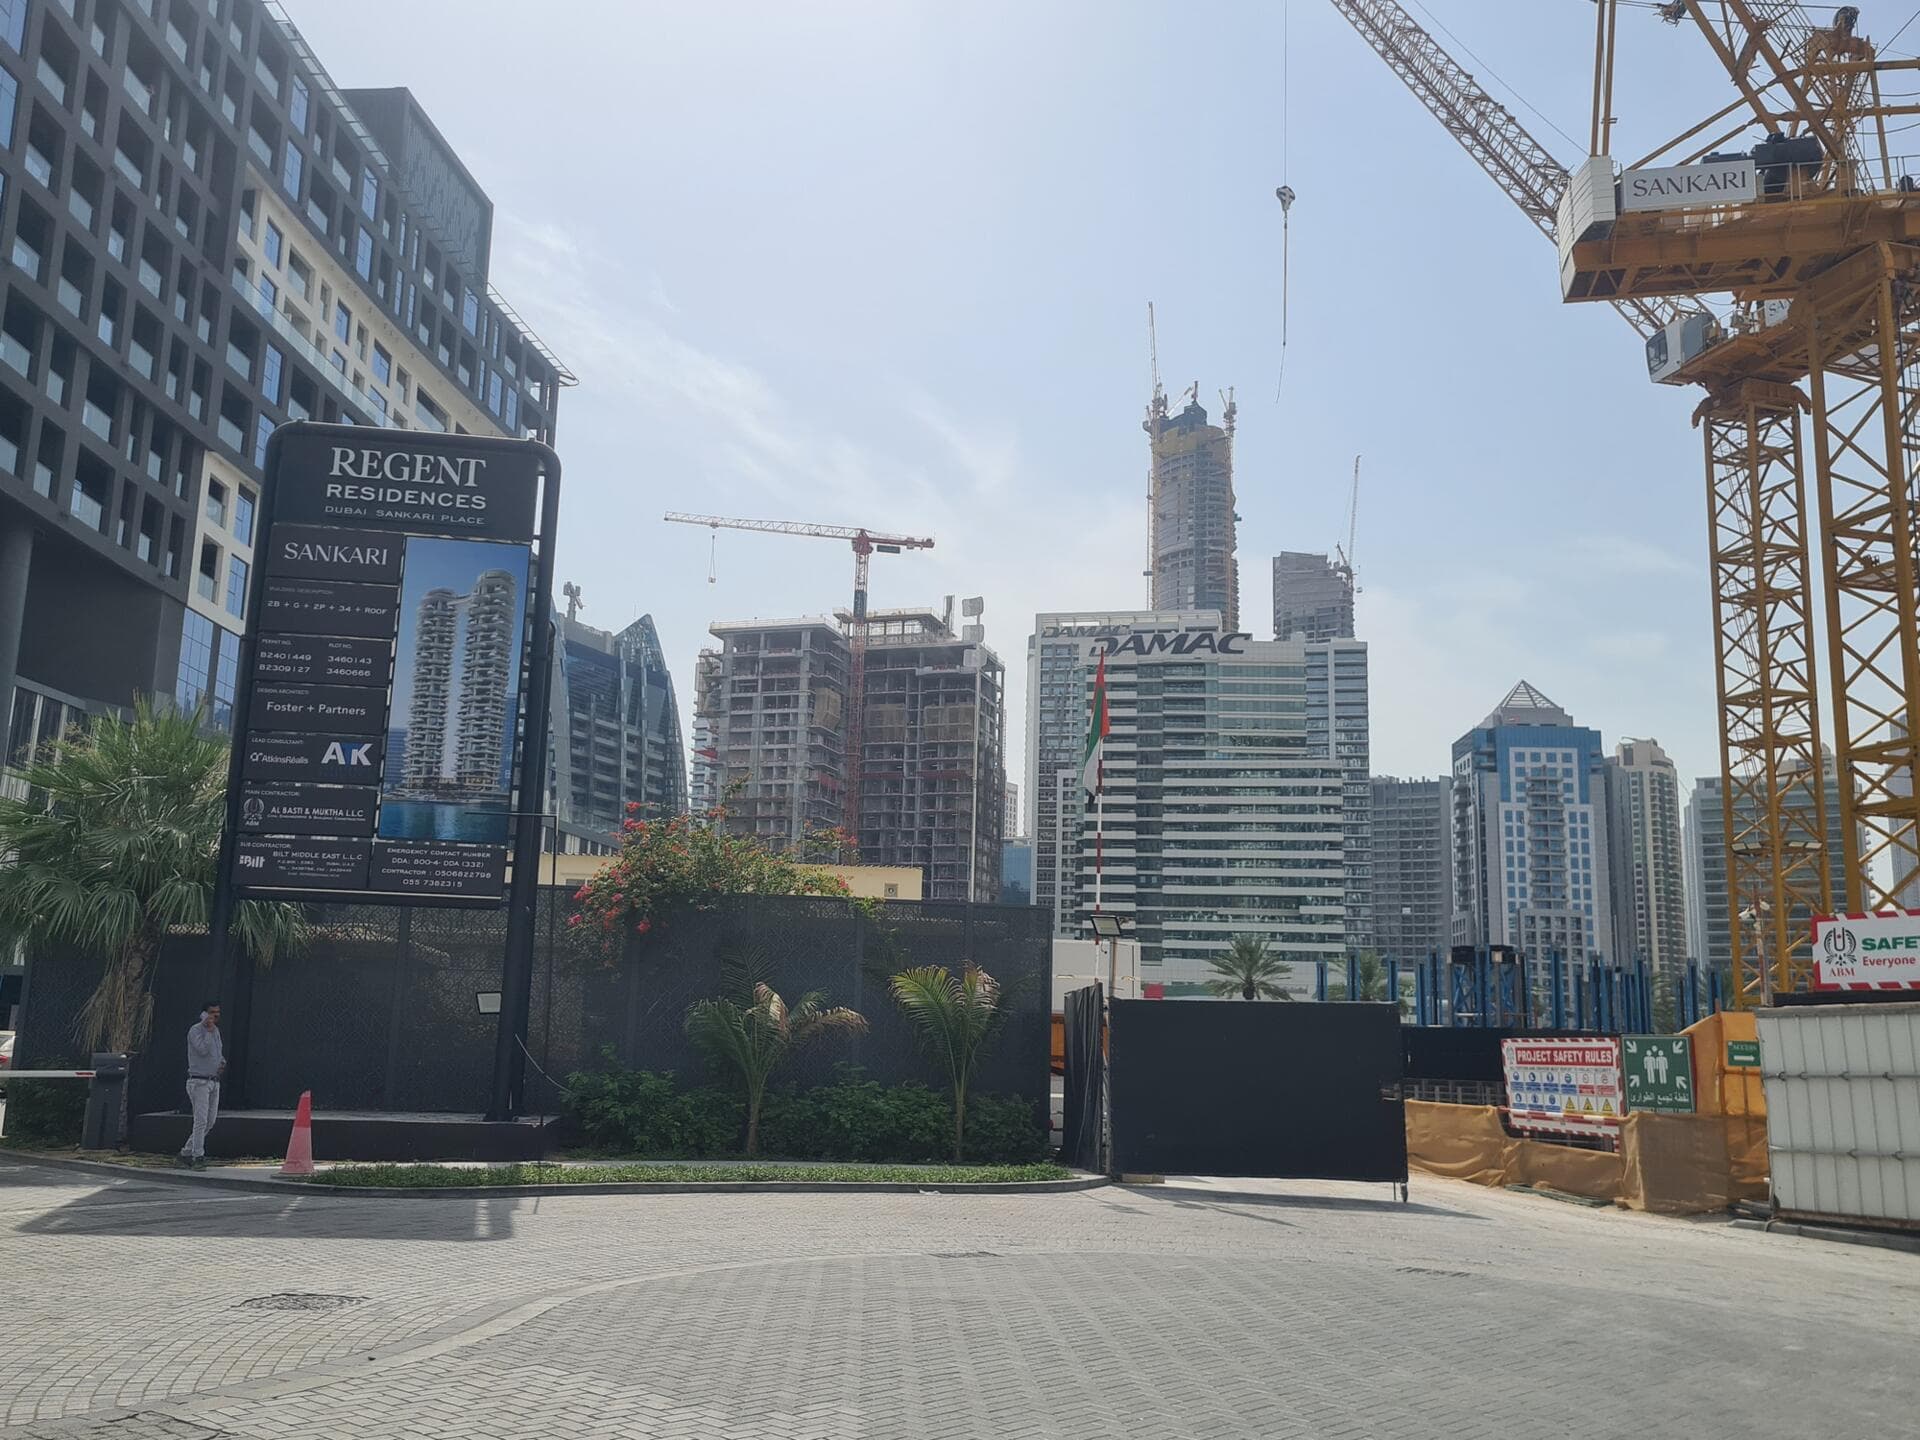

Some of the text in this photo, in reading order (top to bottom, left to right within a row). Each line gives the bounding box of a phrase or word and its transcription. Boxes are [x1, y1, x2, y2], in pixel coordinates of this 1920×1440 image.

[1633, 171, 1746, 197] SANKARI
[329, 447, 486, 487] REGENT
[326, 484, 487, 510] RESIDENCES
[325, 505, 485, 525] DUBAI SANKARI PLACE
[284, 542, 388, 566] SANKARI
[364, 607, 388, 615] ROOF
[1089, 633, 1252, 657] DAMAC
[327, 656, 372, 665] 3460143
[266, 701, 366, 716] Foster + Partners
[270, 806, 280, 814] AL
[282, 807, 303, 815] BASTI
[304, 807, 310, 815] &
[312, 808, 344, 817] MUKTHA
[291, 851, 319, 859] MIDDLE
[382, 867, 427, 875] CONTRACTOR
[1862, 936, 1920, 951] SAFE
[1862, 956, 1916, 968] Everyone
[1517, 1050, 1612, 1063] PROJECT SAFETY RULES
